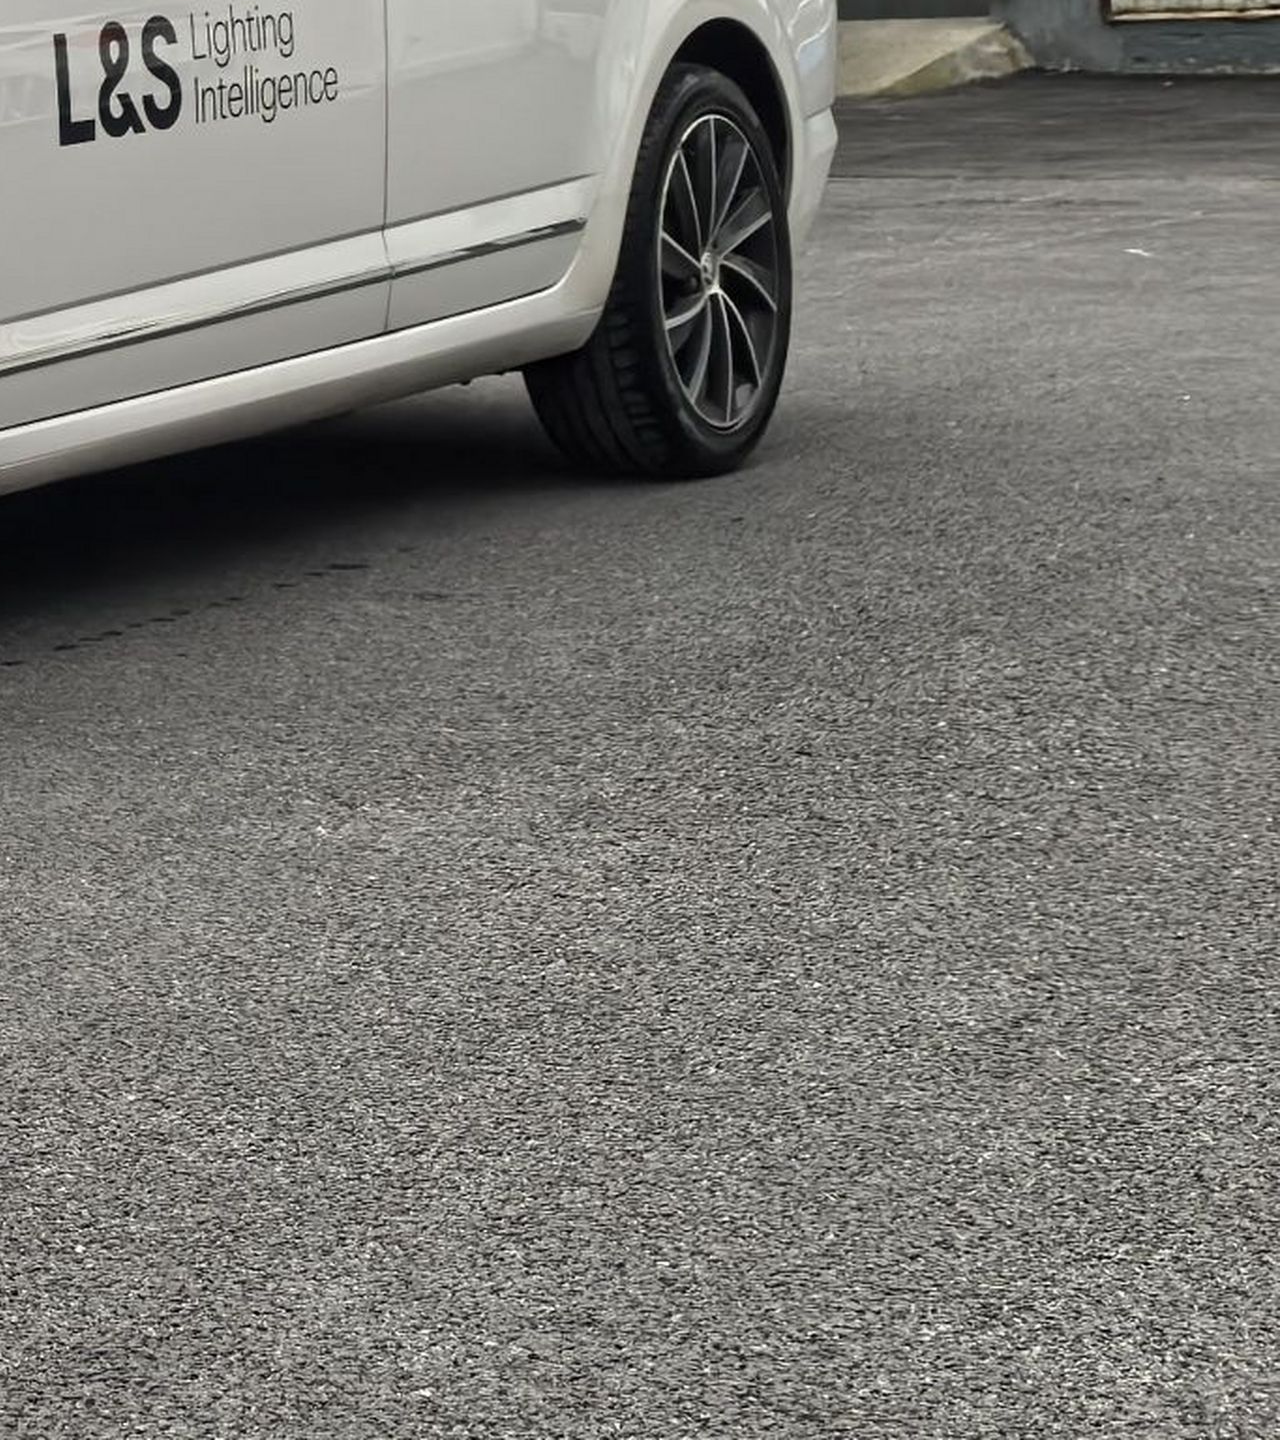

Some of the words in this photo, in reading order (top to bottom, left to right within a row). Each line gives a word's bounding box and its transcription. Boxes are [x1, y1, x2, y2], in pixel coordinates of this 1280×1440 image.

[189, 4, 294, 67] Lighting
[52, 15, 182, 146] L&S
[194, 65, 338, 123] Intelligence
